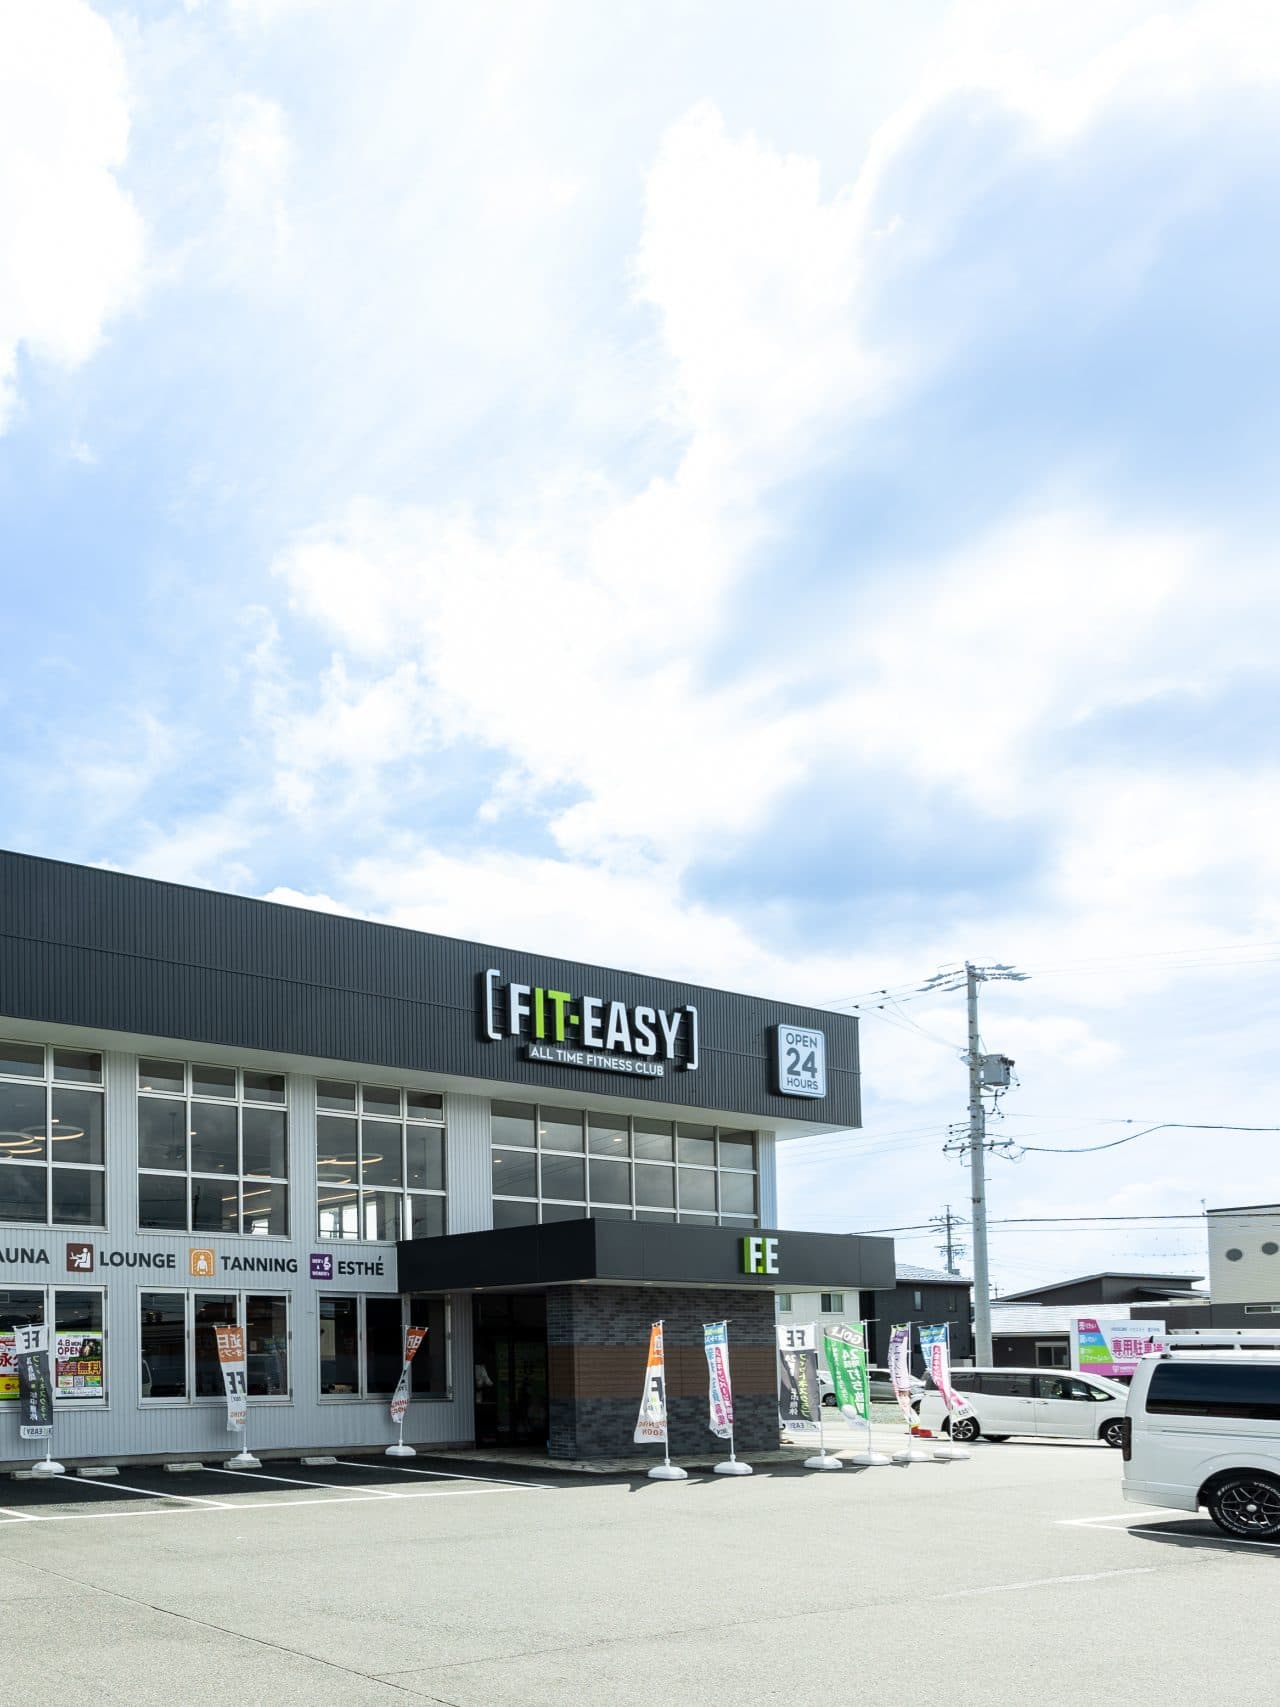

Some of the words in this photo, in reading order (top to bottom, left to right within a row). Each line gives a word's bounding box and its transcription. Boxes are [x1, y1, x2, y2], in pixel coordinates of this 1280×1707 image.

[785, 1032, 818, 1048] OPEN
[531, 1046, 554, 1060] ALL
[556, 1050, 584, 1064] TIME
[586, 1054, 632, 1072] FITNESS
[635, 1062, 664, 1076] CLUB
[786, 1047, 818, 1079] 24
[786, 1077, 819, 1090] HOURS
[99, 1251, 176, 1269] LOUNGE
[220, 1255, 298, 1273] TANNING
[337, 1256, 385, 1276] ESTHÉ
[57, 1346, 80, 1355] OPEN
